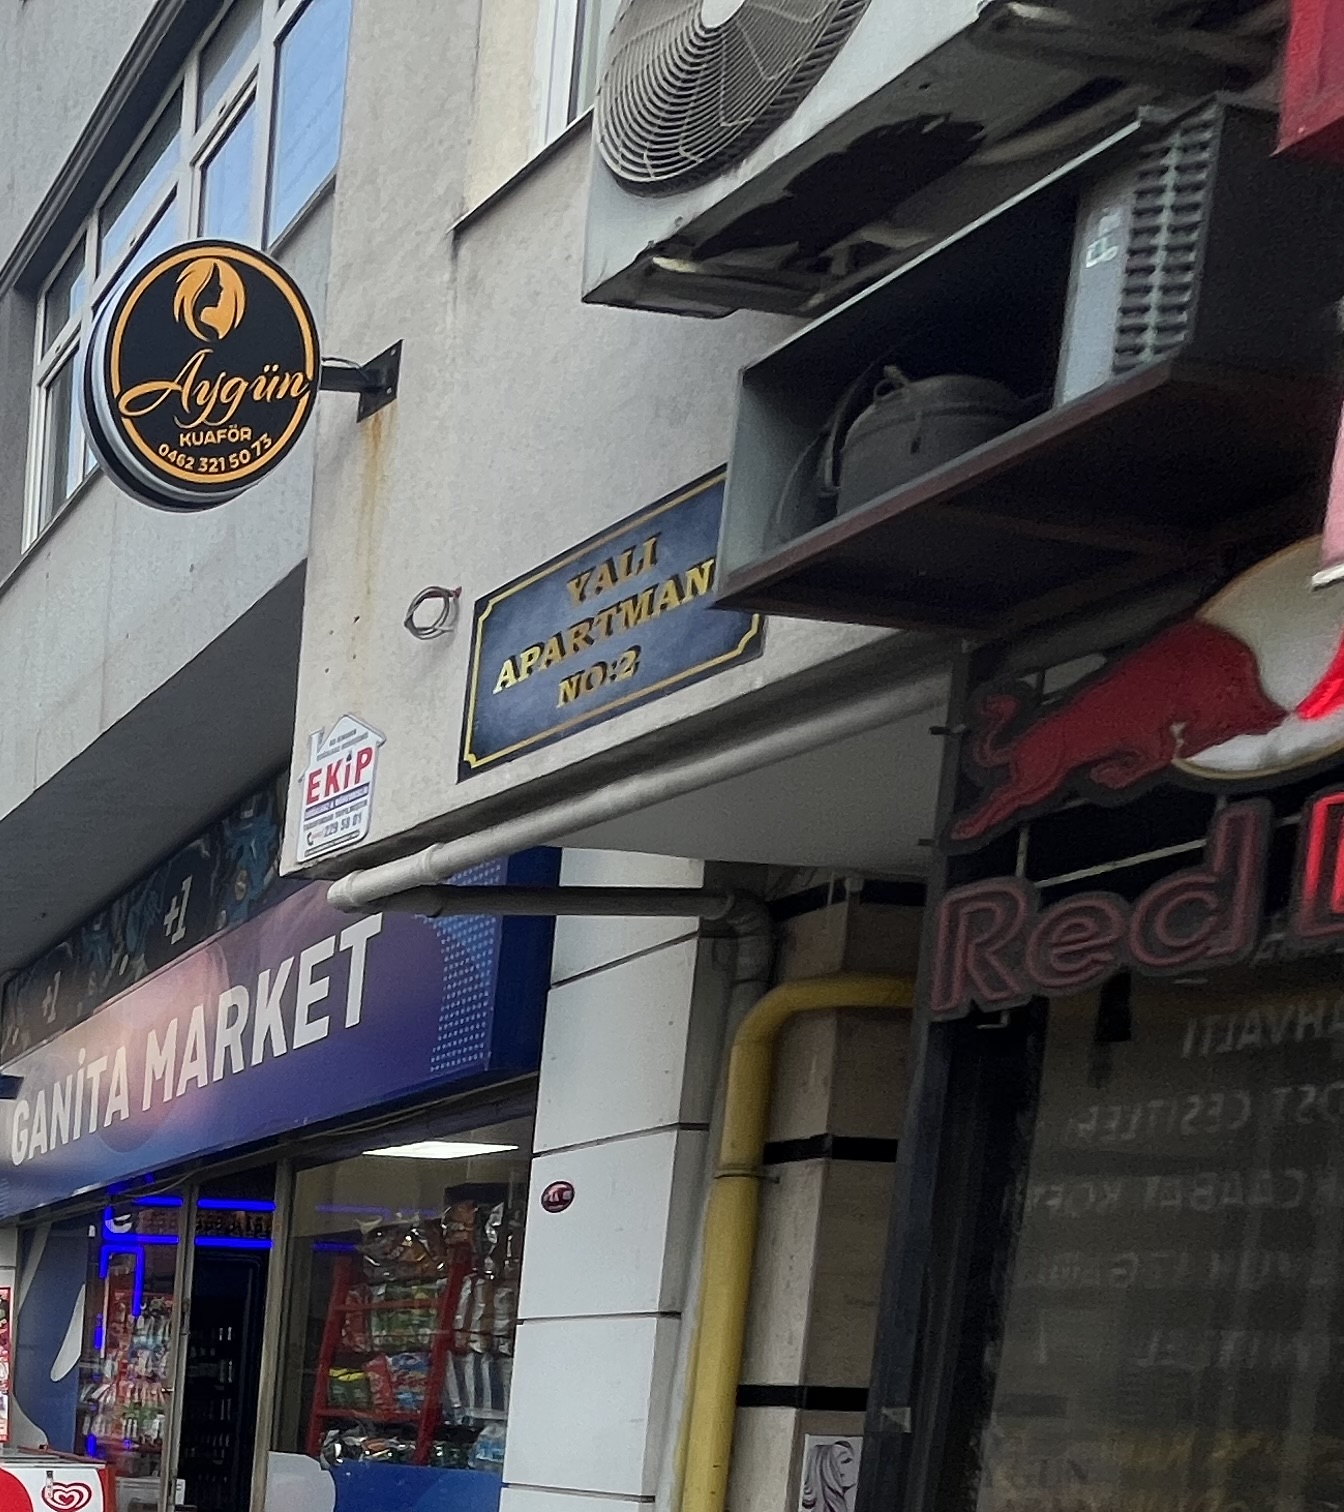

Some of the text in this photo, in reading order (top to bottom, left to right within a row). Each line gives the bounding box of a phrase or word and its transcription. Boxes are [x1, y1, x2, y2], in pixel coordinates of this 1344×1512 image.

[118, 349, 311, 429] Aygün
[158, 432, 273, 473] 0462 321 50 73
[178, 424, 253, 447] KUAFÖR
[566, 532, 661, 607] YALI
[492, 557, 716, 695] APARTMAN
[556, 645, 642, 710] NO:2
[929, 802, 1260, 1015] Red
[11, 911, 384, 1166] GANİTA MARKET
